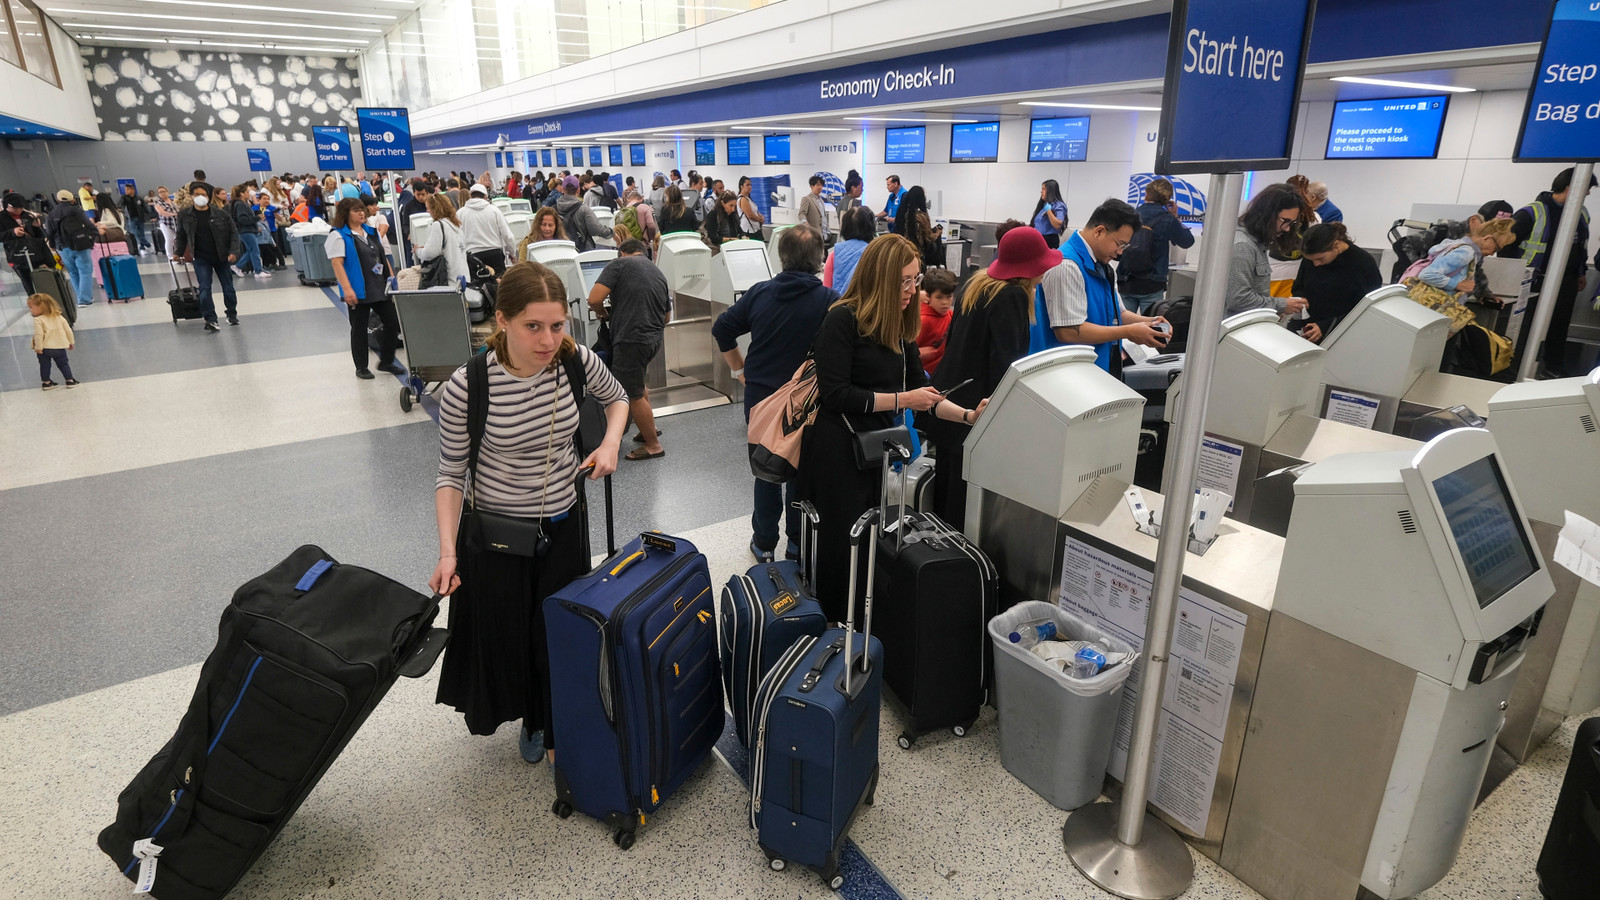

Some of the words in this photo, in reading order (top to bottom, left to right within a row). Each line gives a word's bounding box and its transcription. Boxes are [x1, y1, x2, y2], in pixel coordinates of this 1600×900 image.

[1184, 28, 1238, 77] Start
[1240, 35, 1284, 82] here
[1543, 63, 1598, 84] Step
[820, 79, 880, 99] Economy
[884, 63, 956, 92] Check-In
[1384, 104, 1417, 112] UNITED
[1535, 103, 1581, 124] Bag
[527, 124, 544, 135] Economy
[543, 120, 562, 133] Check-In
[1336, 128, 1360, 136] Please
[1361, 126, 1392, 136] proceed
[364, 132, 382, 142] Step
[1334, 136, 1347, 144] the
[1348, 136, 1365, 144] next
[1366, 136, 1386, 145] open
[1387, 135, 1409, 143] kiosk
[317, 143, 331, 151] Step
[366, 148, 386, 156] Start
[387, 147, 406, 156] here
[819, 144, 848, 153] UNITED
[1342, 144, 1363, 152] check
[1365, 144, 1375, 152] in.
[1068, 543, 1084, 555] About
[1084, 550, 1111, 567] hazardous
[1110, 562, 1137, 579] materials
[773, 595, 793, 611] Lucas
[1063, 595, 1077, 606] About
[1077, 602, 1098, 617] baggage
